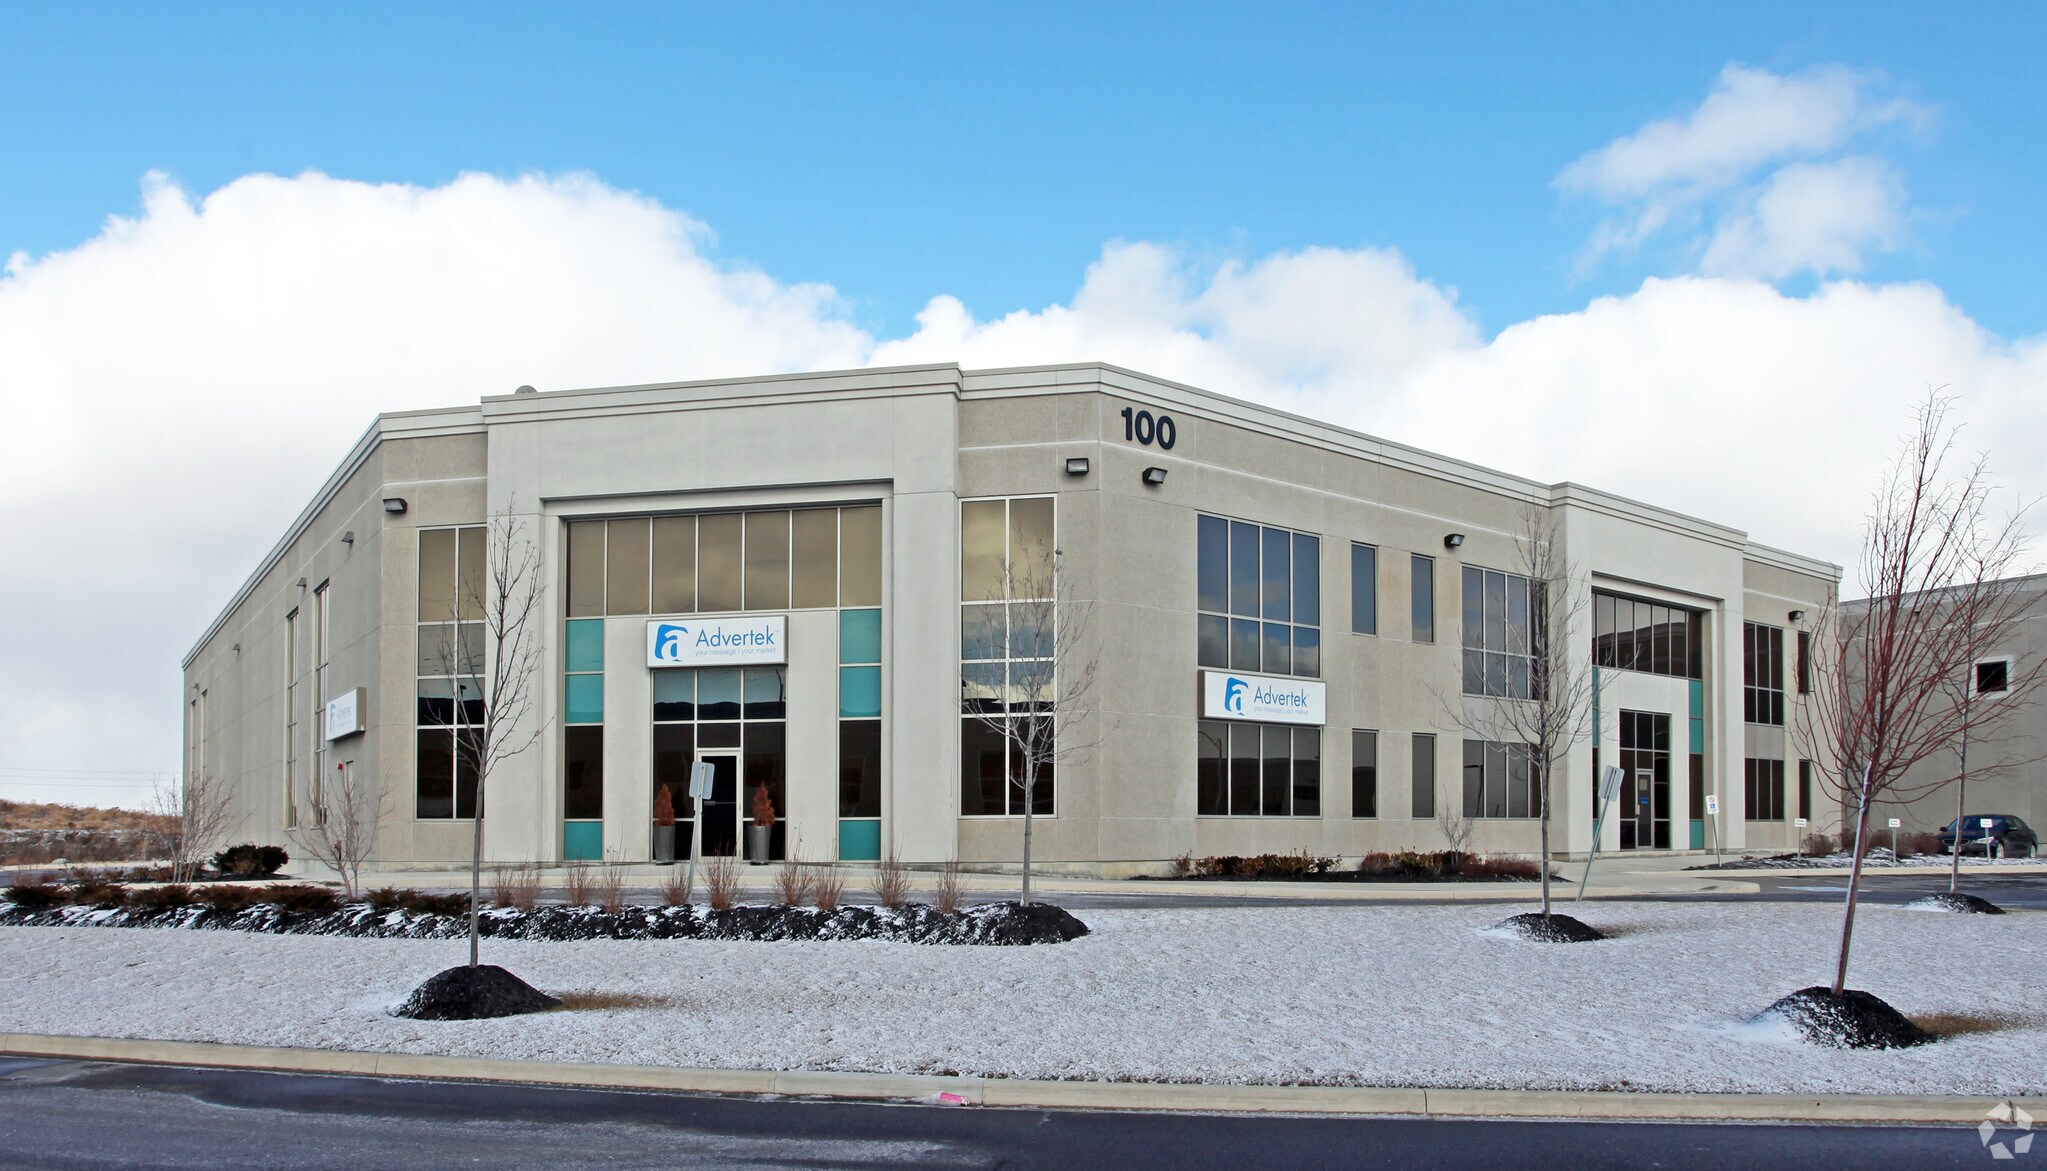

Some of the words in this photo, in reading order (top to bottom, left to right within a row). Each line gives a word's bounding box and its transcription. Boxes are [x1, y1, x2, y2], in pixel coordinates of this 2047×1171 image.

[1121, 406, 1176, 450] 100
[695, 625, 775, 647] Advertek
[695, 649, 708, 657] your
[709, 648, 736, 656] message
[1253, 685, 1307, 707] Advertek
